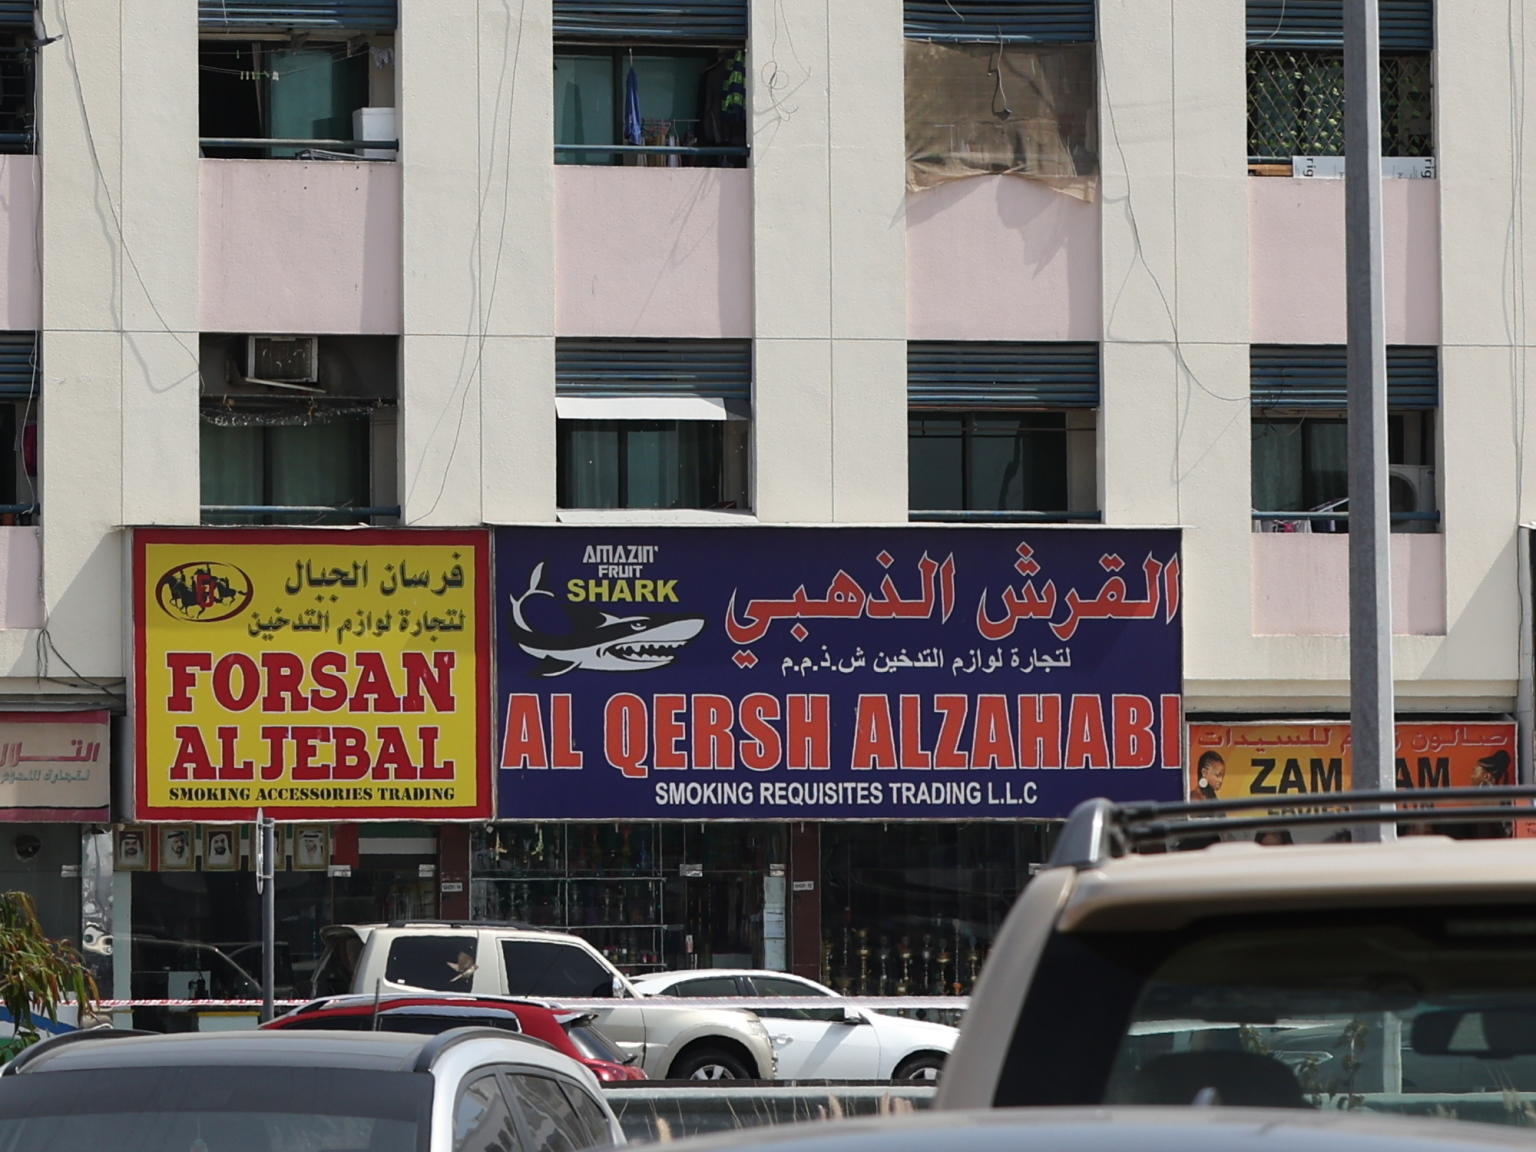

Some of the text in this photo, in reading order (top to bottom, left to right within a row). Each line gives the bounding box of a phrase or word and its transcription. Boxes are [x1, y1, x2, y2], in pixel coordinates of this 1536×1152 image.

[284, 552, 464, 603] فرسان الجبال
[597, 564, 644, 579] FRUIT
[566, 579, 680, 603] SHARK
[724, 541, 1181, 669] القرش الذهبي
[247, 607, 466, 645] لتجارة لوازم التدخين
[873, 647, 945, 675] التدخين
[952, 648, 1003, 677] لوازم
[1009, 647, 1072, 671] لتجارة
[165, 650, 457, 713] FORSAN
[500, 692, 1183, 779] AL QERSH ALZAHABI
[1197, 726, 1332, 755] للسيدات
[168, 786, 455, 801] SMOKING ACCESSORIES TRADING
[655, 781, 1038, 805] SMOKING REQUISITES TRADING L.L.C
